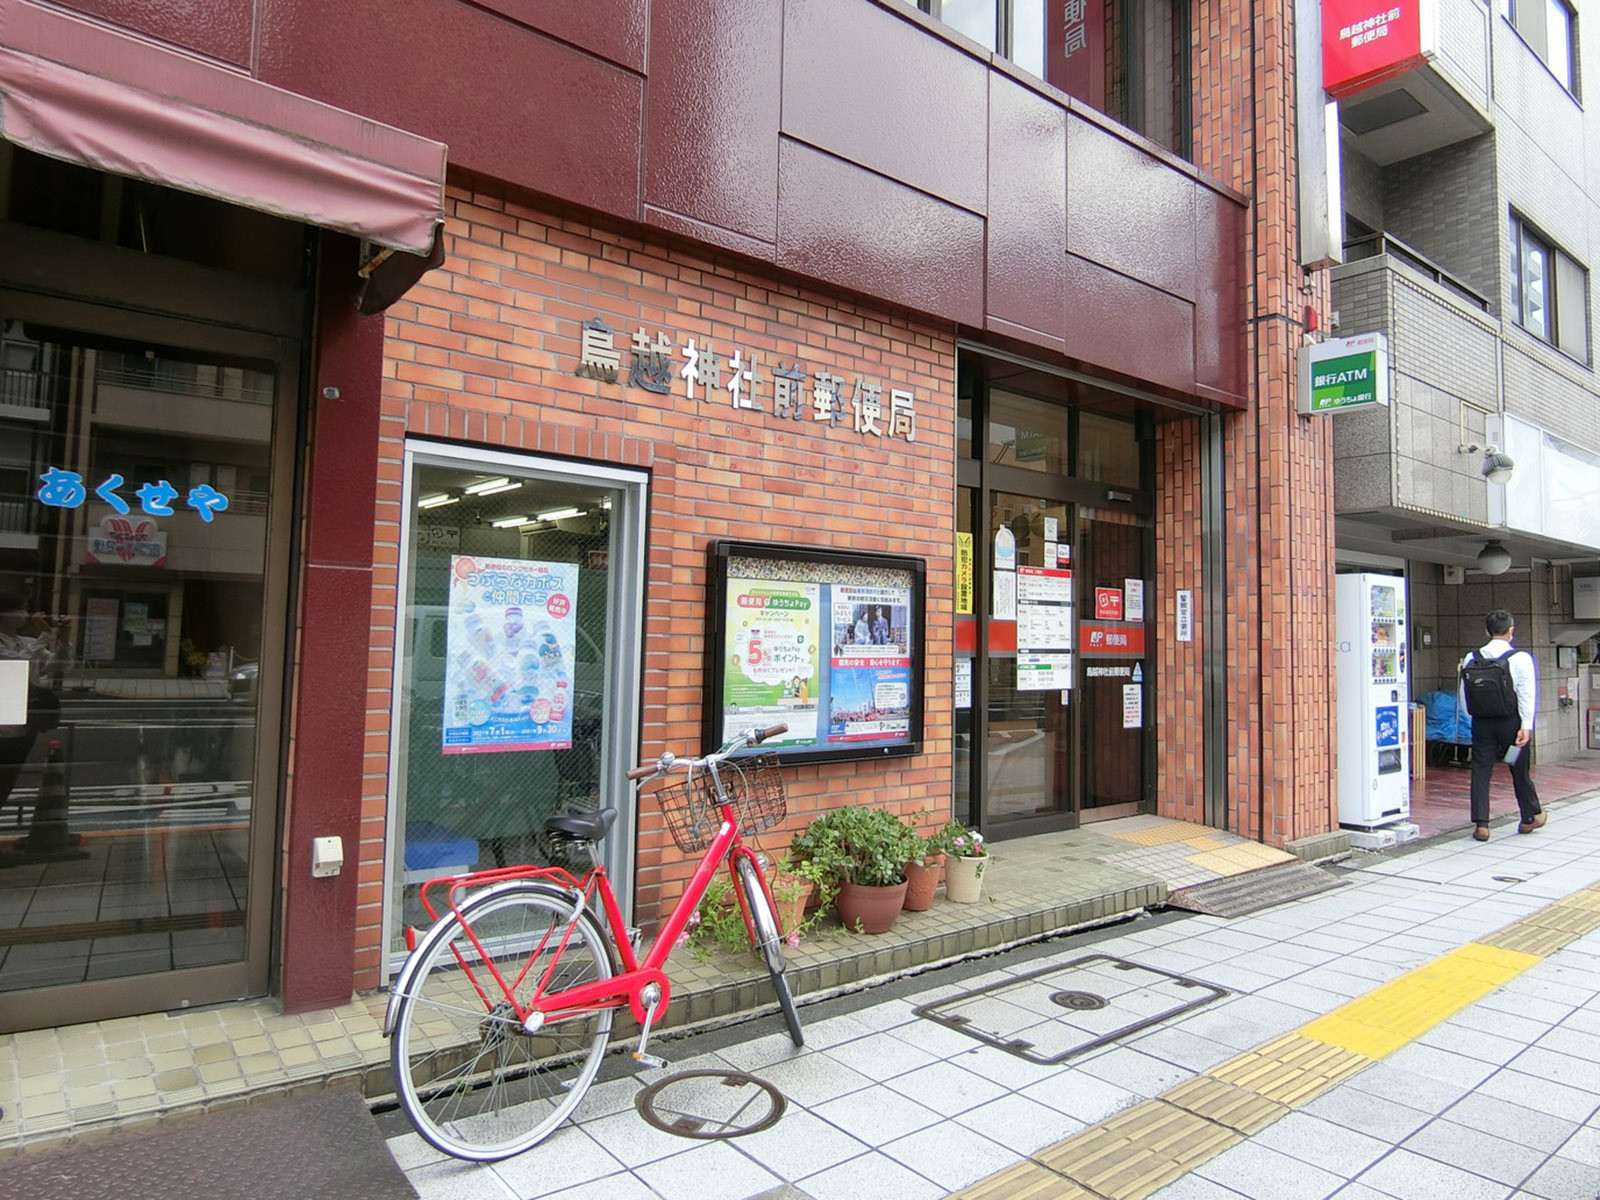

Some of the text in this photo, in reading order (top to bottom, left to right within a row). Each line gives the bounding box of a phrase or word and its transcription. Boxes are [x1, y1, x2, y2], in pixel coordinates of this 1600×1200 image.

[1339, 7, 1401, 40] 鳥越神社前
[1350, 25, 1388, 48] 郵便局
[575, 317, 917, 442] 鳥越神社前郵便局
[1314, 368, 1367, 387] 銀行ATM
[1333, 392, 1372, 405] ゆうちょ銀行
[37, 466, 230, 523] あくせや
[466, 571, 565, 591] つぶらなカボス
[1105, 633, 1128, 646] 郵便局
